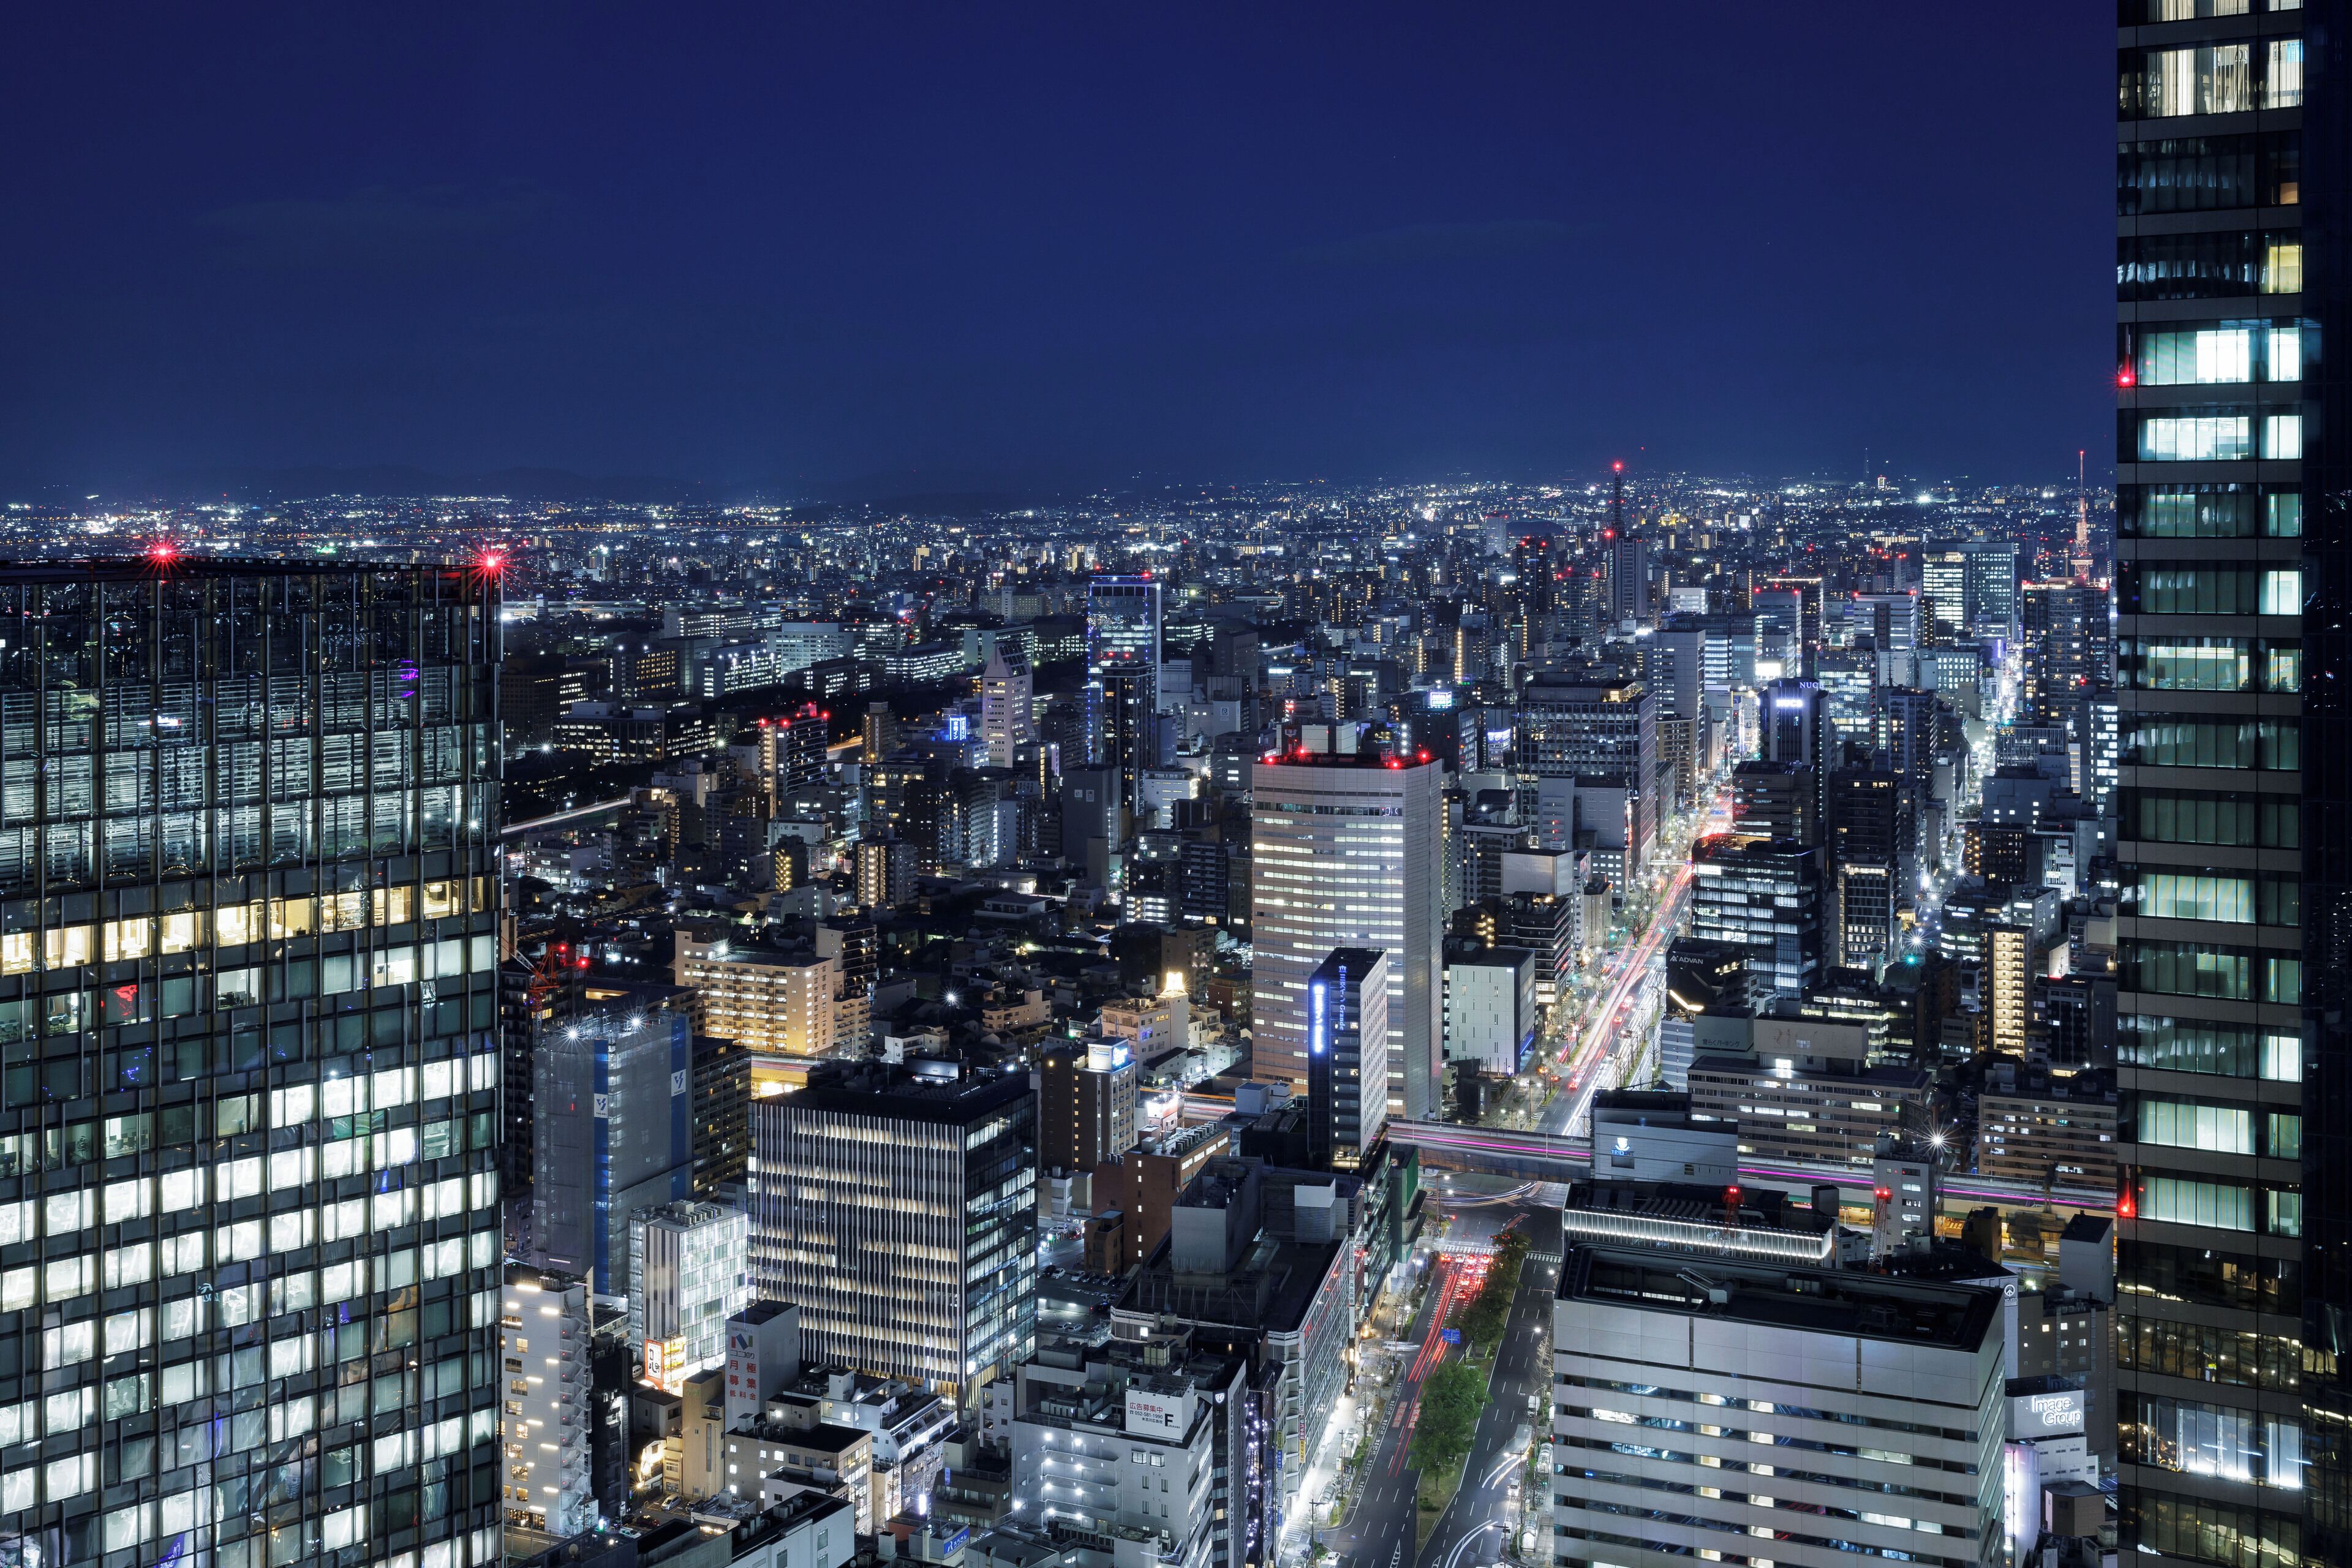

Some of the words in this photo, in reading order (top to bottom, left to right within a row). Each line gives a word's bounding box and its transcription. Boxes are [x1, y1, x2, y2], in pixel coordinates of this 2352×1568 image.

[729, 1349, 755, 1359] ニコニコのり
[729, 1360, 756, 1373] 月極
[729, 1374, 756, 1389] 募集
[729, 1390, 756, 1400] 低料金
[1129, 1402, 1163, 1414] 広告募集中
[2032, 1397, 2071, 1413] Image
[1134, 1410, 1163, 1419] 052-581-1990
[2044, 1411, 2082, 1425] Group
[953, 1534, 967, 1548] ろうきん
